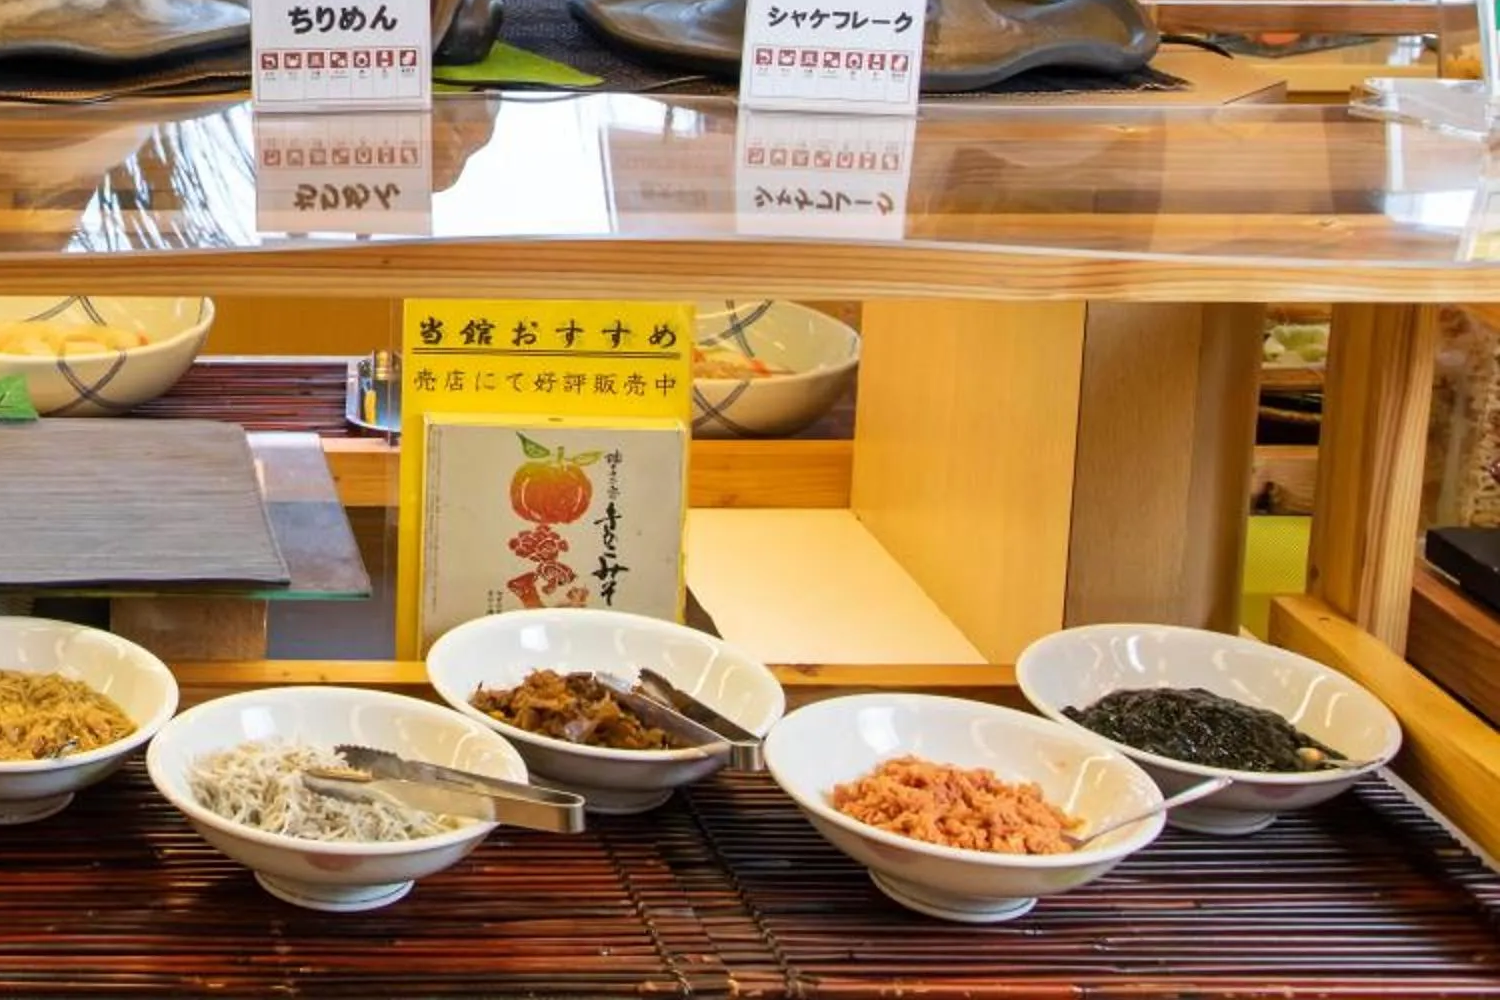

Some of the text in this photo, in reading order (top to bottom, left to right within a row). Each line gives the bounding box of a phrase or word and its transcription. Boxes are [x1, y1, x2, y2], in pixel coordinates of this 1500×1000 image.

[287, 5, 397, 35] ちりめん
[768, 6, 913, 33] シャケフレーク
[419, 316, 677, 348] 当館おすすめ
[414, 368, 677, 397] 売店にて好評販売中
